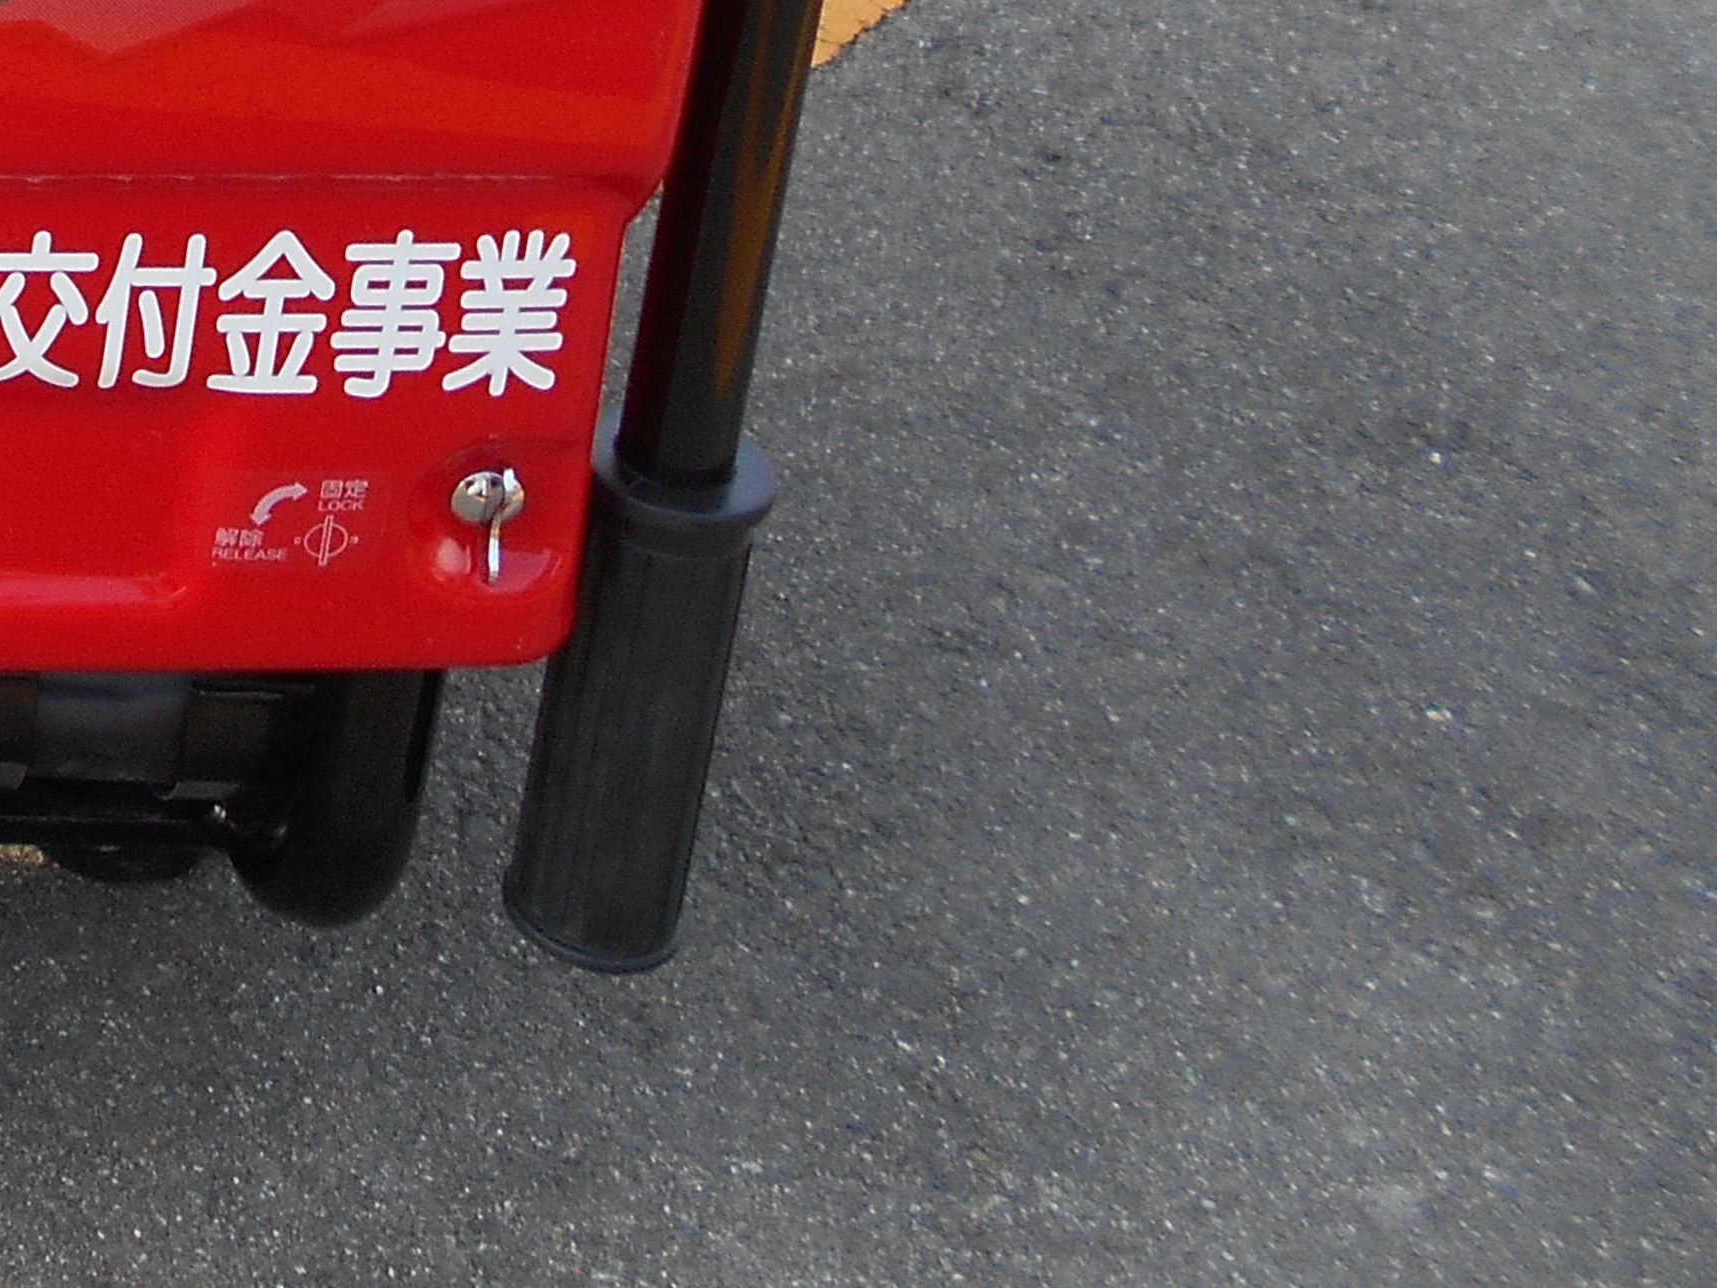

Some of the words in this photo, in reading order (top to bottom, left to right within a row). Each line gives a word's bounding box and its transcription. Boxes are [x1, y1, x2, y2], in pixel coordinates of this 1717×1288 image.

[320, 479, 368, 499] 固定
[318, 500, 364, 512] LOCK
[215, 527, 264, 548] 解除
[212, 547, 287, 561] RELEASE
